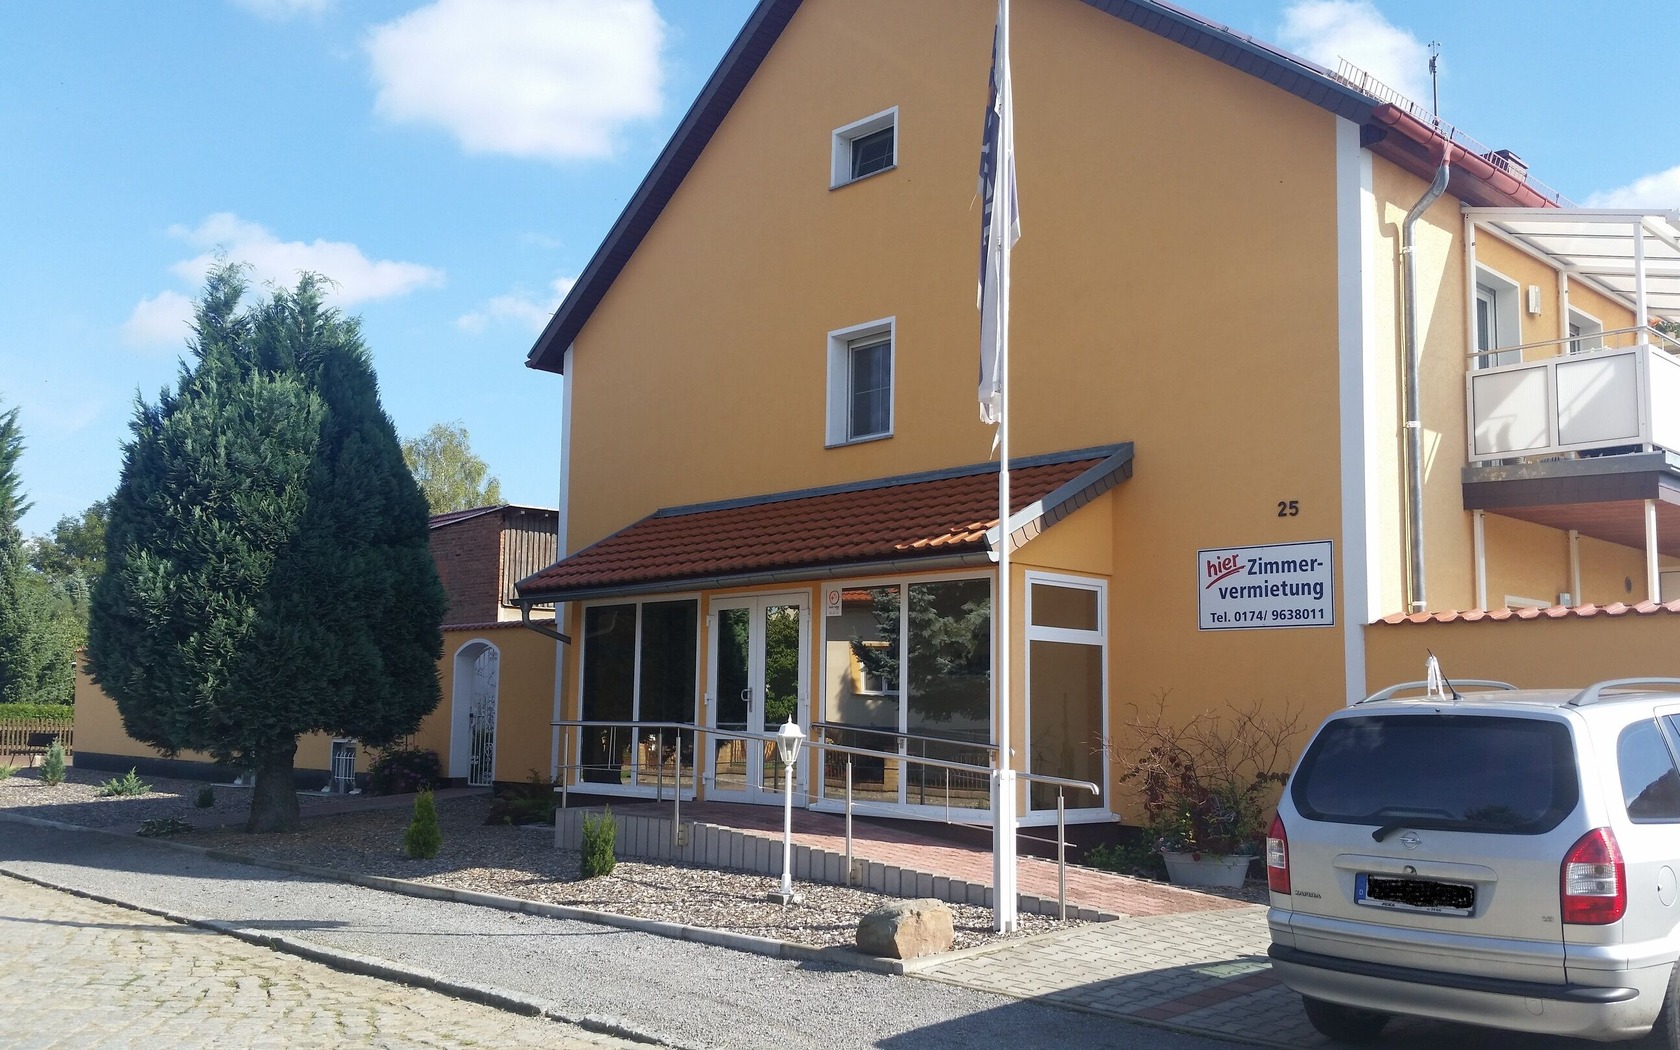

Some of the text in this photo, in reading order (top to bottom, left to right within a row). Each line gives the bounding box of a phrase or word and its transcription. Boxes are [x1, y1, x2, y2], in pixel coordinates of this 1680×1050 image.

[1278, 501, 1299, 517] 25
[1207, 554, 1323, 577] hier Zimmer-
[1218, 580, 1324, 600] vermietung
[1210, 608, 1324, 622] Tel. 0174/ 9638011
